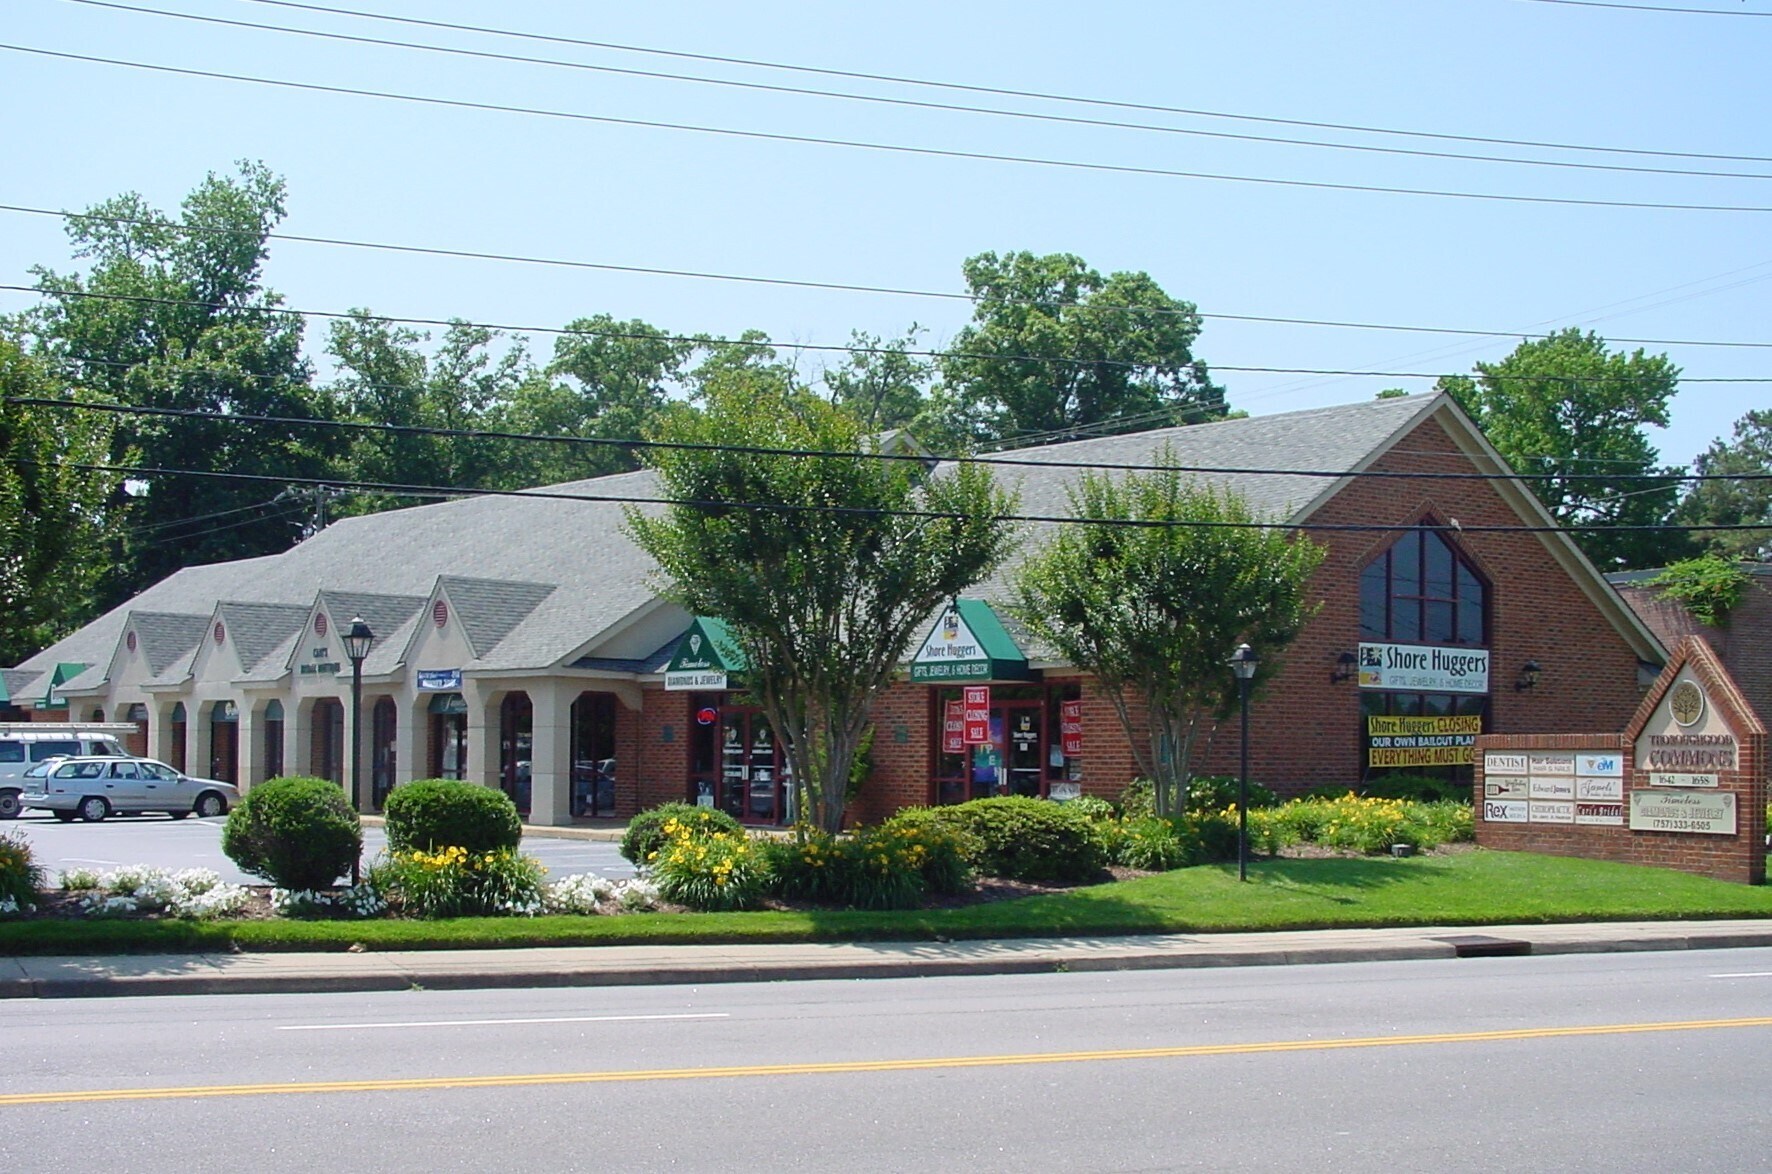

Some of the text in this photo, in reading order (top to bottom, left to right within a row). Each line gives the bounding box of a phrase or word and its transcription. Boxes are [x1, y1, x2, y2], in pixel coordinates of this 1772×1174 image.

[1387, 646, 1486, 676] Shore Huggers
[694, 676, 699, 686] &
[699, 675, 723, 686] JEWELRY
[1370, 715, 1479, 735] Shore Huggers CLOSING
[1371, 737, 1391, 747] OUR
[1393, 737, 1416, 747] OWN
[1418, 736, 1454, 747] BAILOUT
[1371, 748, 1431, 766] EVERYTHING
[1434, 747, 1459, 763] MUST
[1487, 757, 1526, 768] DENTIST
[1649, 749, 1733, 768] COMMONS
[1658, 775, 1676, 784] 1642
[1691, 775, 1710, 785] 1658
[1660, 794, 1701, 806] Timeless
[1485, 803, 1508, 819] Rex
